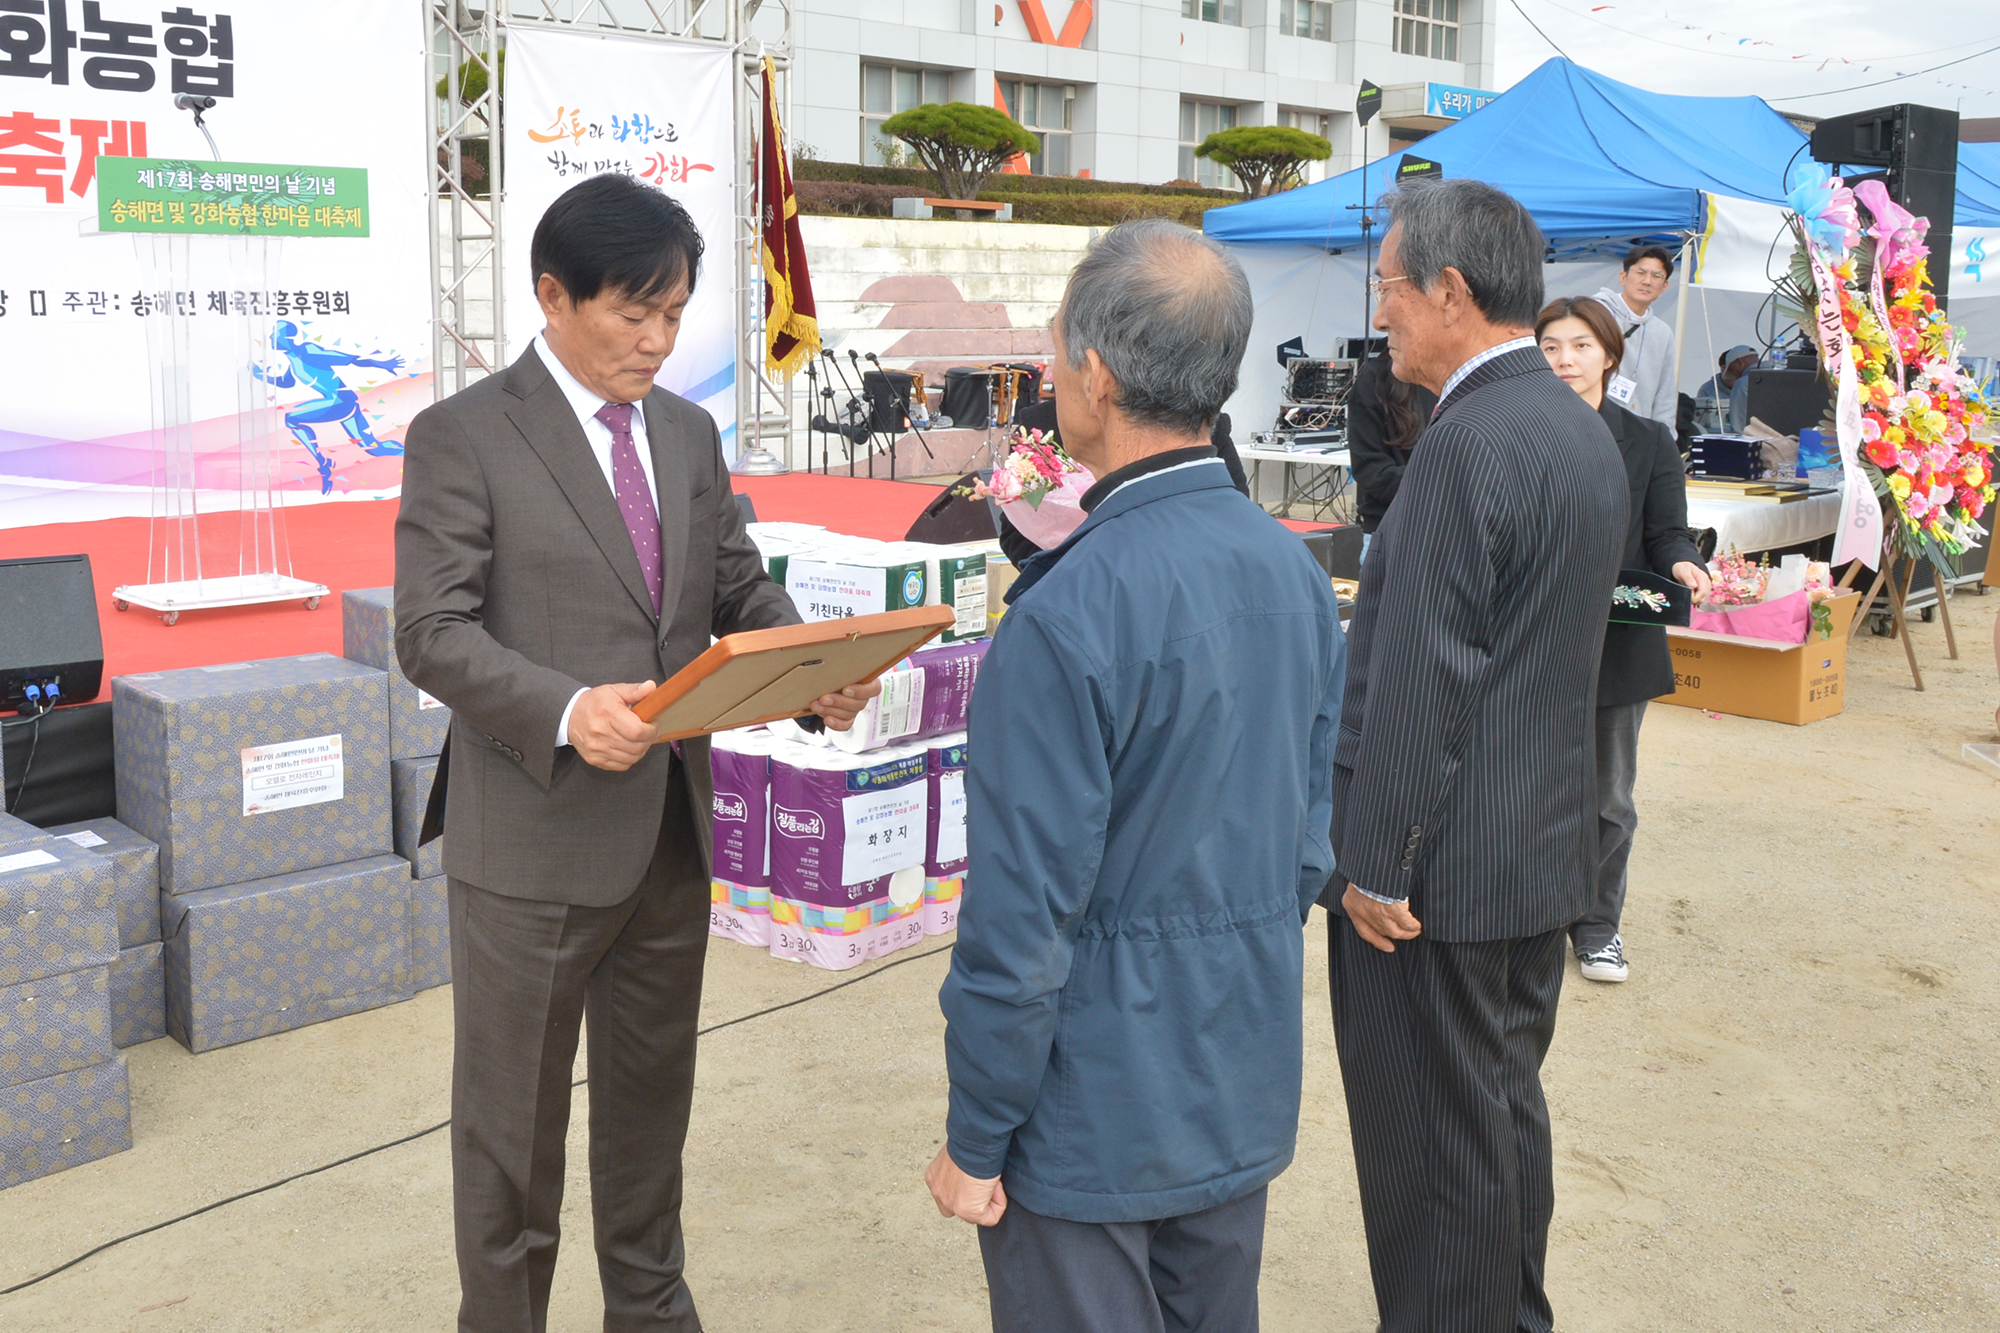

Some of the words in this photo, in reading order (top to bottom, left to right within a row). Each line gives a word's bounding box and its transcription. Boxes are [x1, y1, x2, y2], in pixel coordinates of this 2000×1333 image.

[1441, 90, 1472, 114] 우리가
[0, 111, 148, 204] 축제
[547, 150, 588, 177] 함께
[639, 151, 715, 185] 강화
[1402, 162, 1431, 173] SHURE
[136, 168, 194, 191] 제17회
[198, 172, 280, 194] 송해면민의
[285, 175, 301, 195] 날
[305, 176, 337, 196] 기념
[109, 198, 165, 224] 송해면
[168, 201, 186, 225] 및
[189, 201, 259, 227] 강화농협
[261, 204, 311, 228] 한마음
[313, 206, 363, 229] 대축제
[130, 290, 197, 317] 송해면
[777, 812, 820, 834] 잘풀리는집
